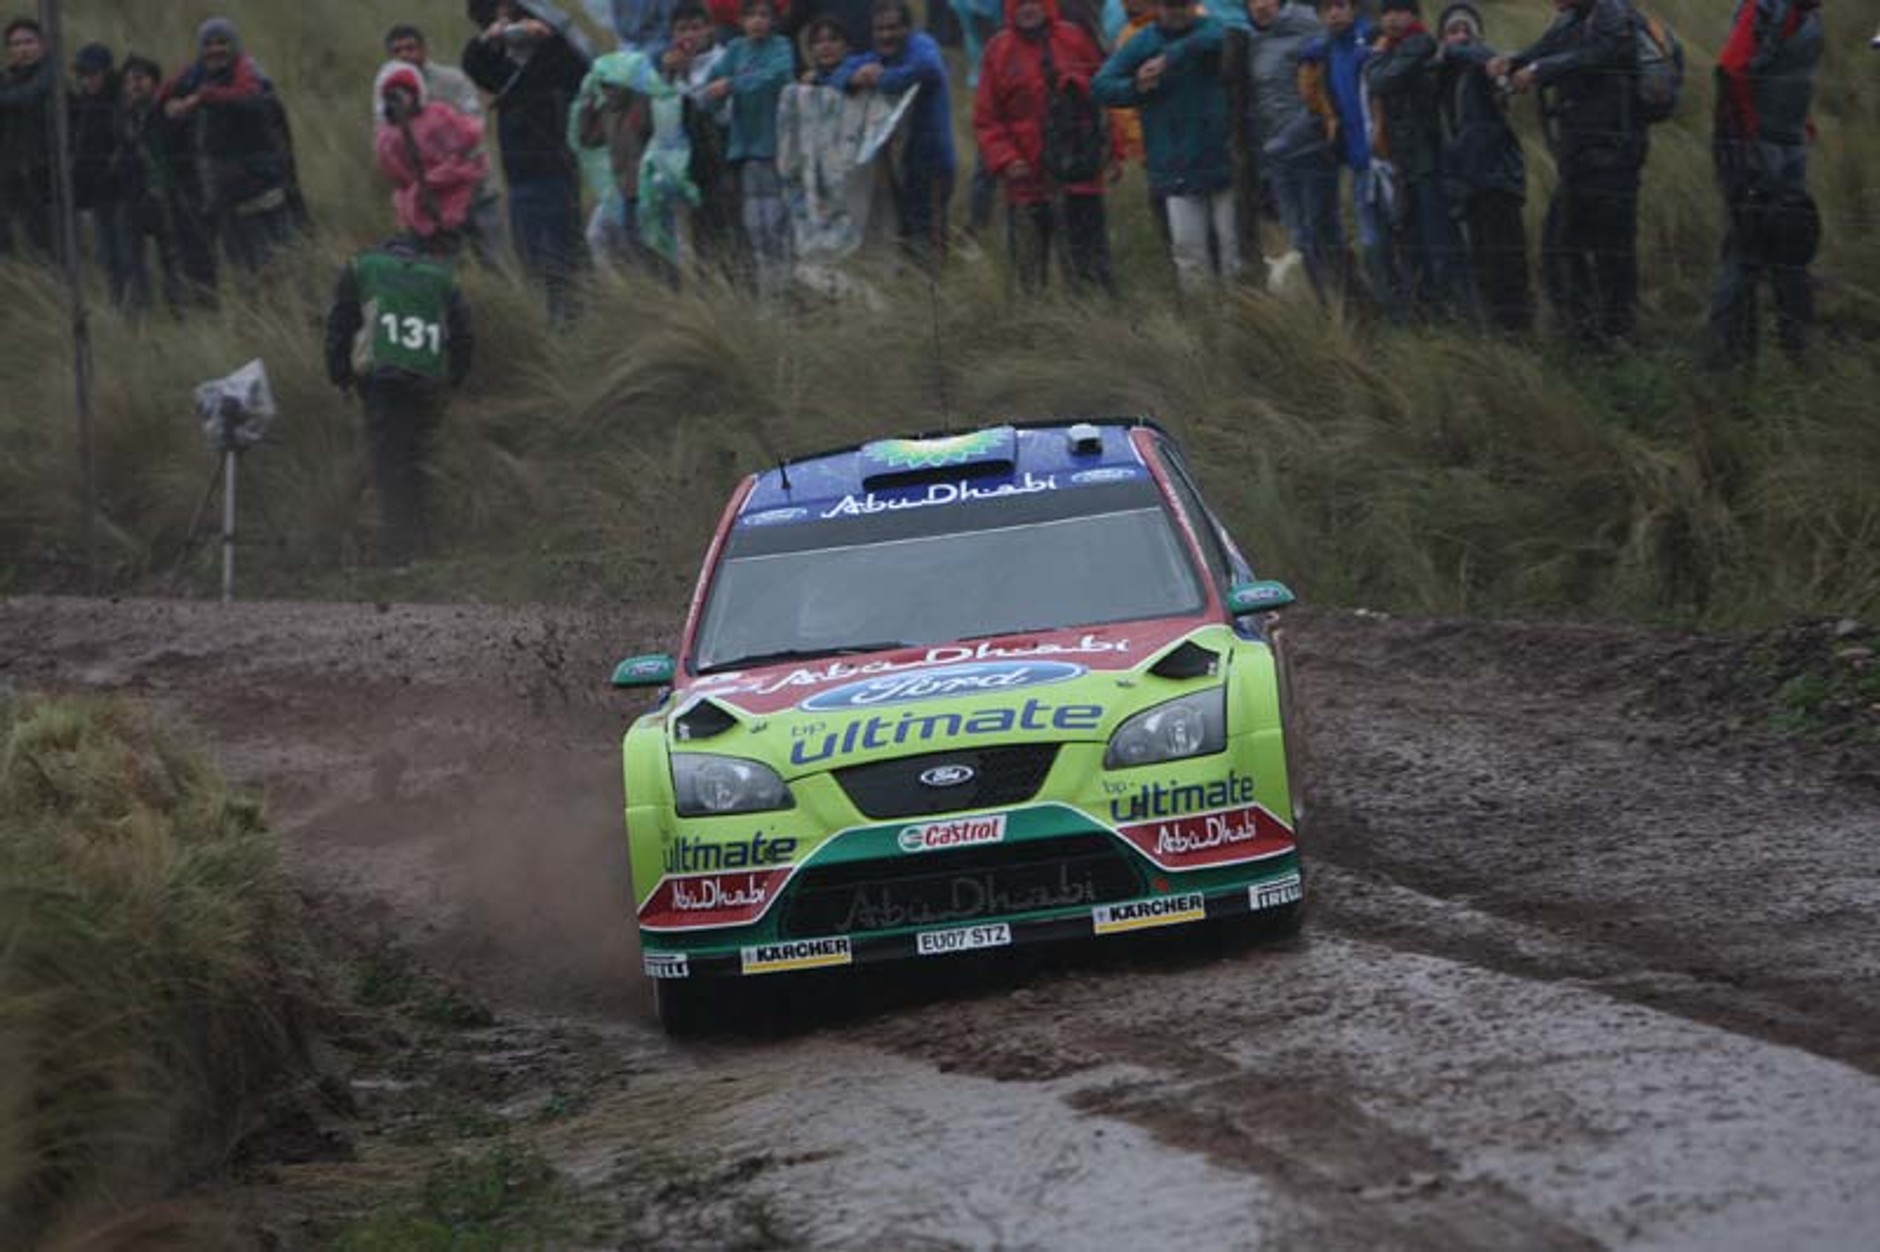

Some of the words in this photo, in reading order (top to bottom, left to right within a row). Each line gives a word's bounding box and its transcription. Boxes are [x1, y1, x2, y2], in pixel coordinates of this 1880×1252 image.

[381, 312, 439, 355] 131
[850, 667, 1031, 704] Ford
[790, 699, 1104, 765] ultimate
[1110, 770, 1254, 822] ultimate
[663, 831, 798, 874] ultimate
[926, 819, 999, 846] Castrol
[921, 930, 966, 950] EU07
[970, 926, 1006, 944] STZ
